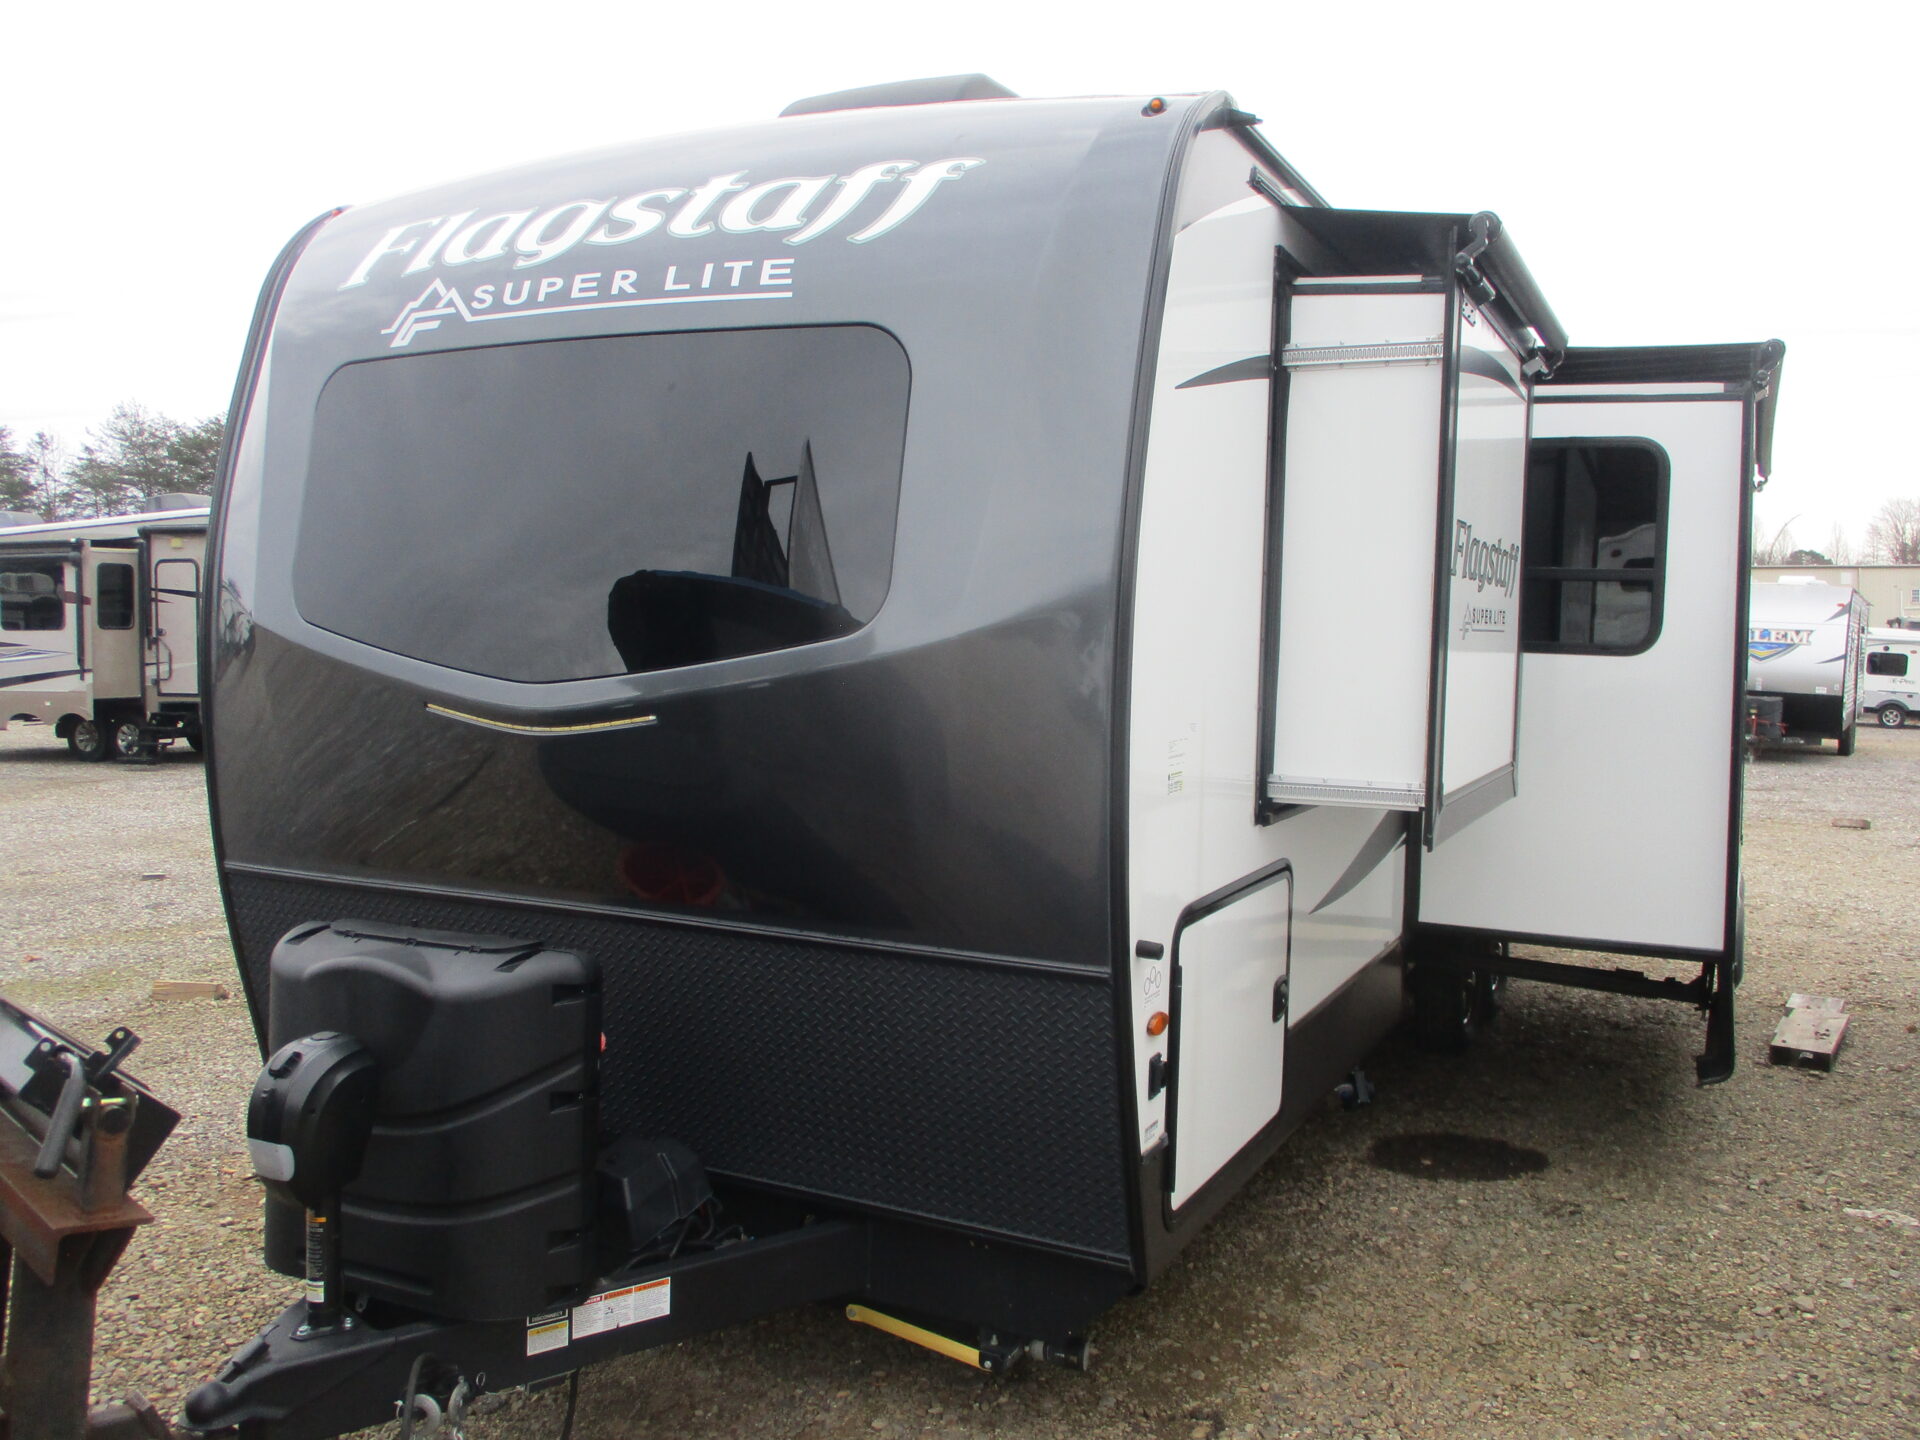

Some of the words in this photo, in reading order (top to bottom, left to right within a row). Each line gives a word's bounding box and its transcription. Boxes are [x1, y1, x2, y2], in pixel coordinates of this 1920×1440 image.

[338, 157, 987, 291] Flagstaff
[470, 268, 639, 310] SUPER
[664, 257, 796, 292] LITE
[1450, 519, 1519, 598] Flagstaff
[1472, 608, 1492, 624] SUPER
[1494, 609, 1505, 625] LITE
[1750, 629, 1814, 645] LEM
